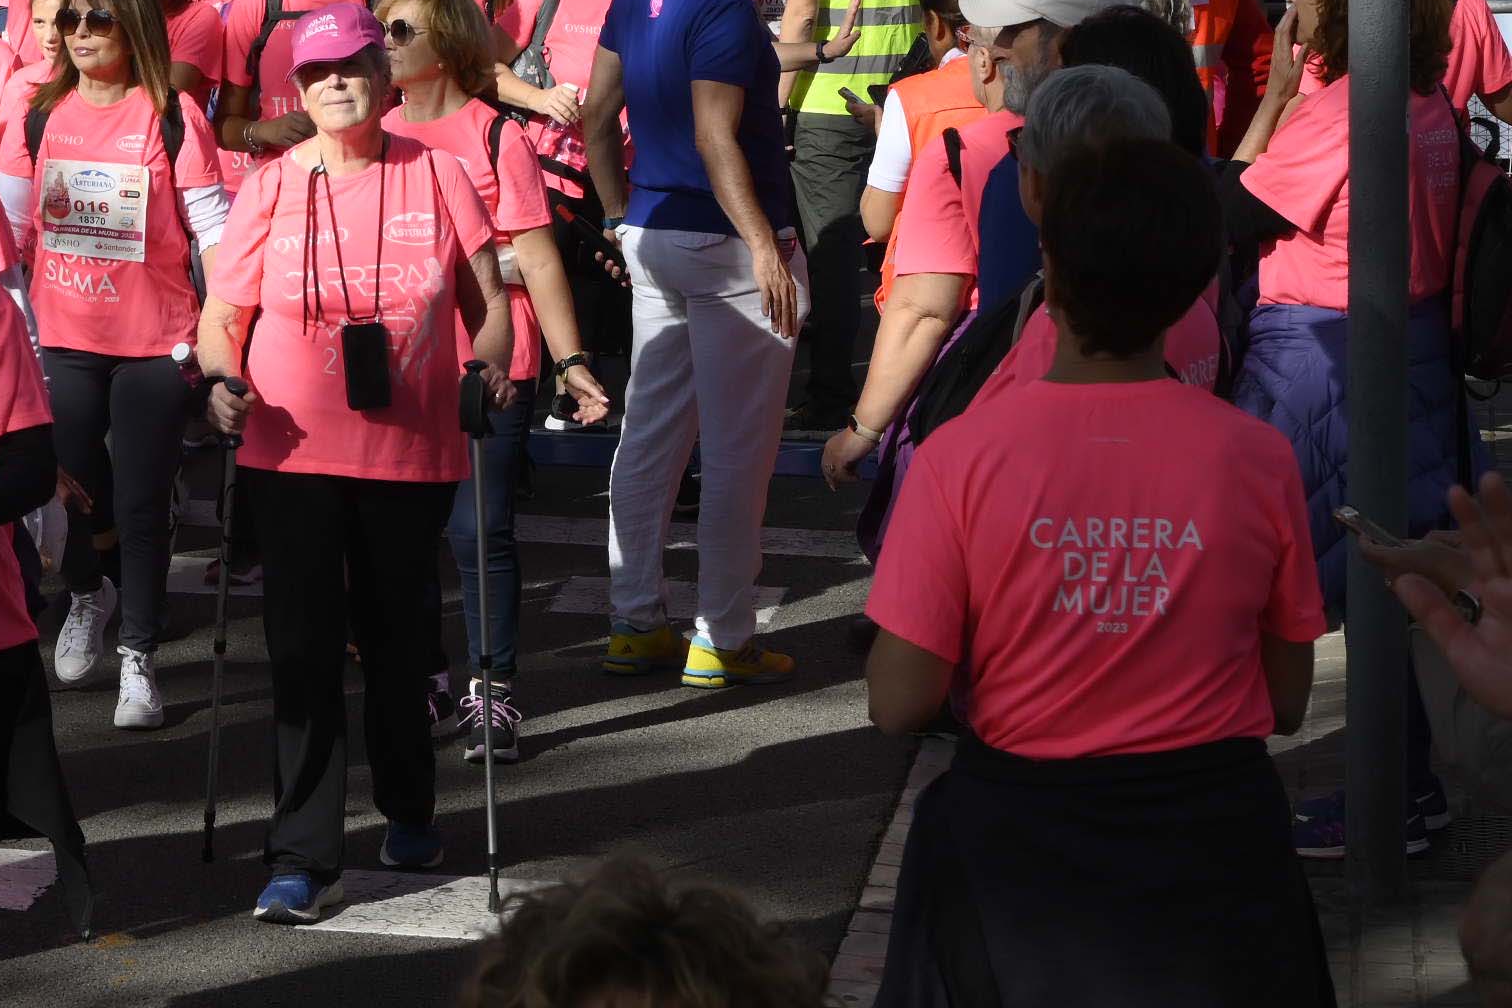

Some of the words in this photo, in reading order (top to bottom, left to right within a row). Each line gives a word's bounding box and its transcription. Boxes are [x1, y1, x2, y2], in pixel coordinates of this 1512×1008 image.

[72, 176, 113, 190] ASTURIANA
[73, 199, 110, 214] 016
[79, 215, 106, 226] 18370
[103, 242, 137, 253] Santander
[45, 258, 118, 295] SUMA
[1028, 517, 1204, 550] CARRERA
[1063, 551, 1109, 582] DE
[1123, 552, 1169, 583] LA
[1052, 585, 1171, 616] MUJER
[1096, 621, 1129, 634] 2023
